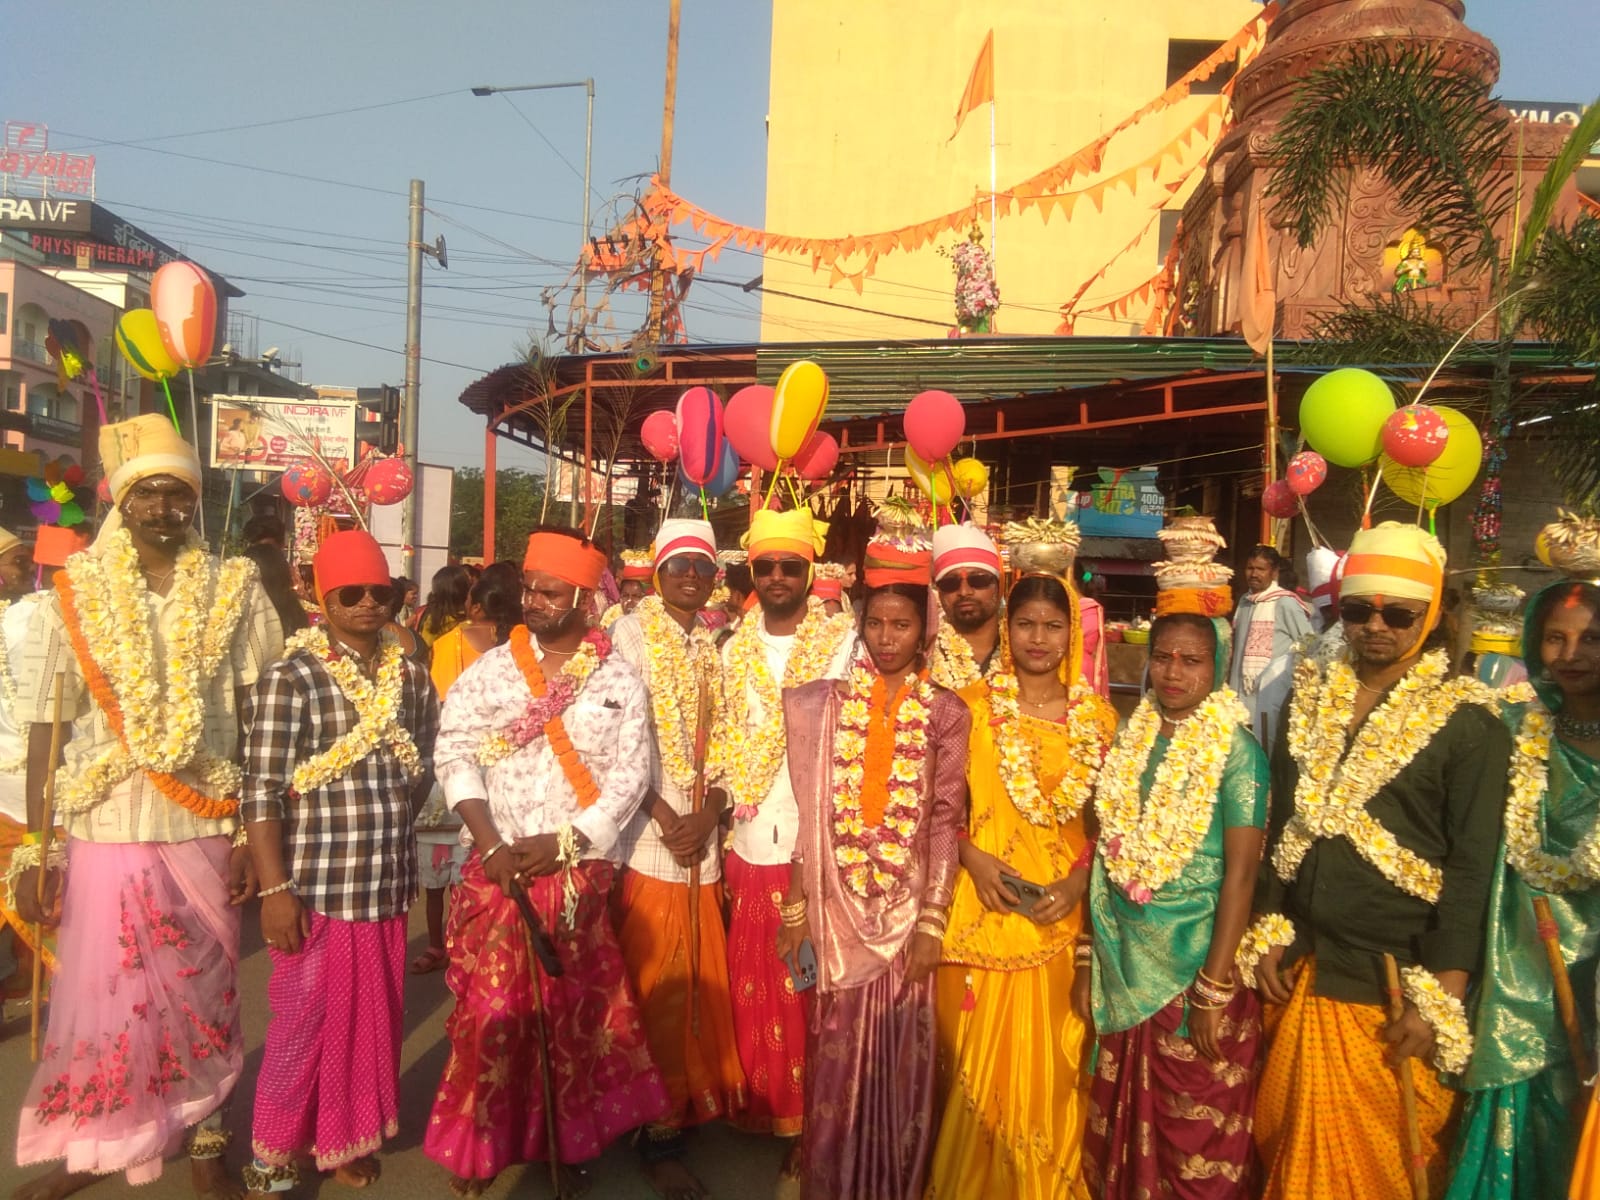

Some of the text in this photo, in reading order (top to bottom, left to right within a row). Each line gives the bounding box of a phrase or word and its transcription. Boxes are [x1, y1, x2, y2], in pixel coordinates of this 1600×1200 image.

[40, 200, 78, 223] IVF
[31, 233, 156, 268] PHYSIOTHERAPY
[284, 405, 347, 418] INDIRA IVF
[1098, 483, 1137, 500] ETRA
